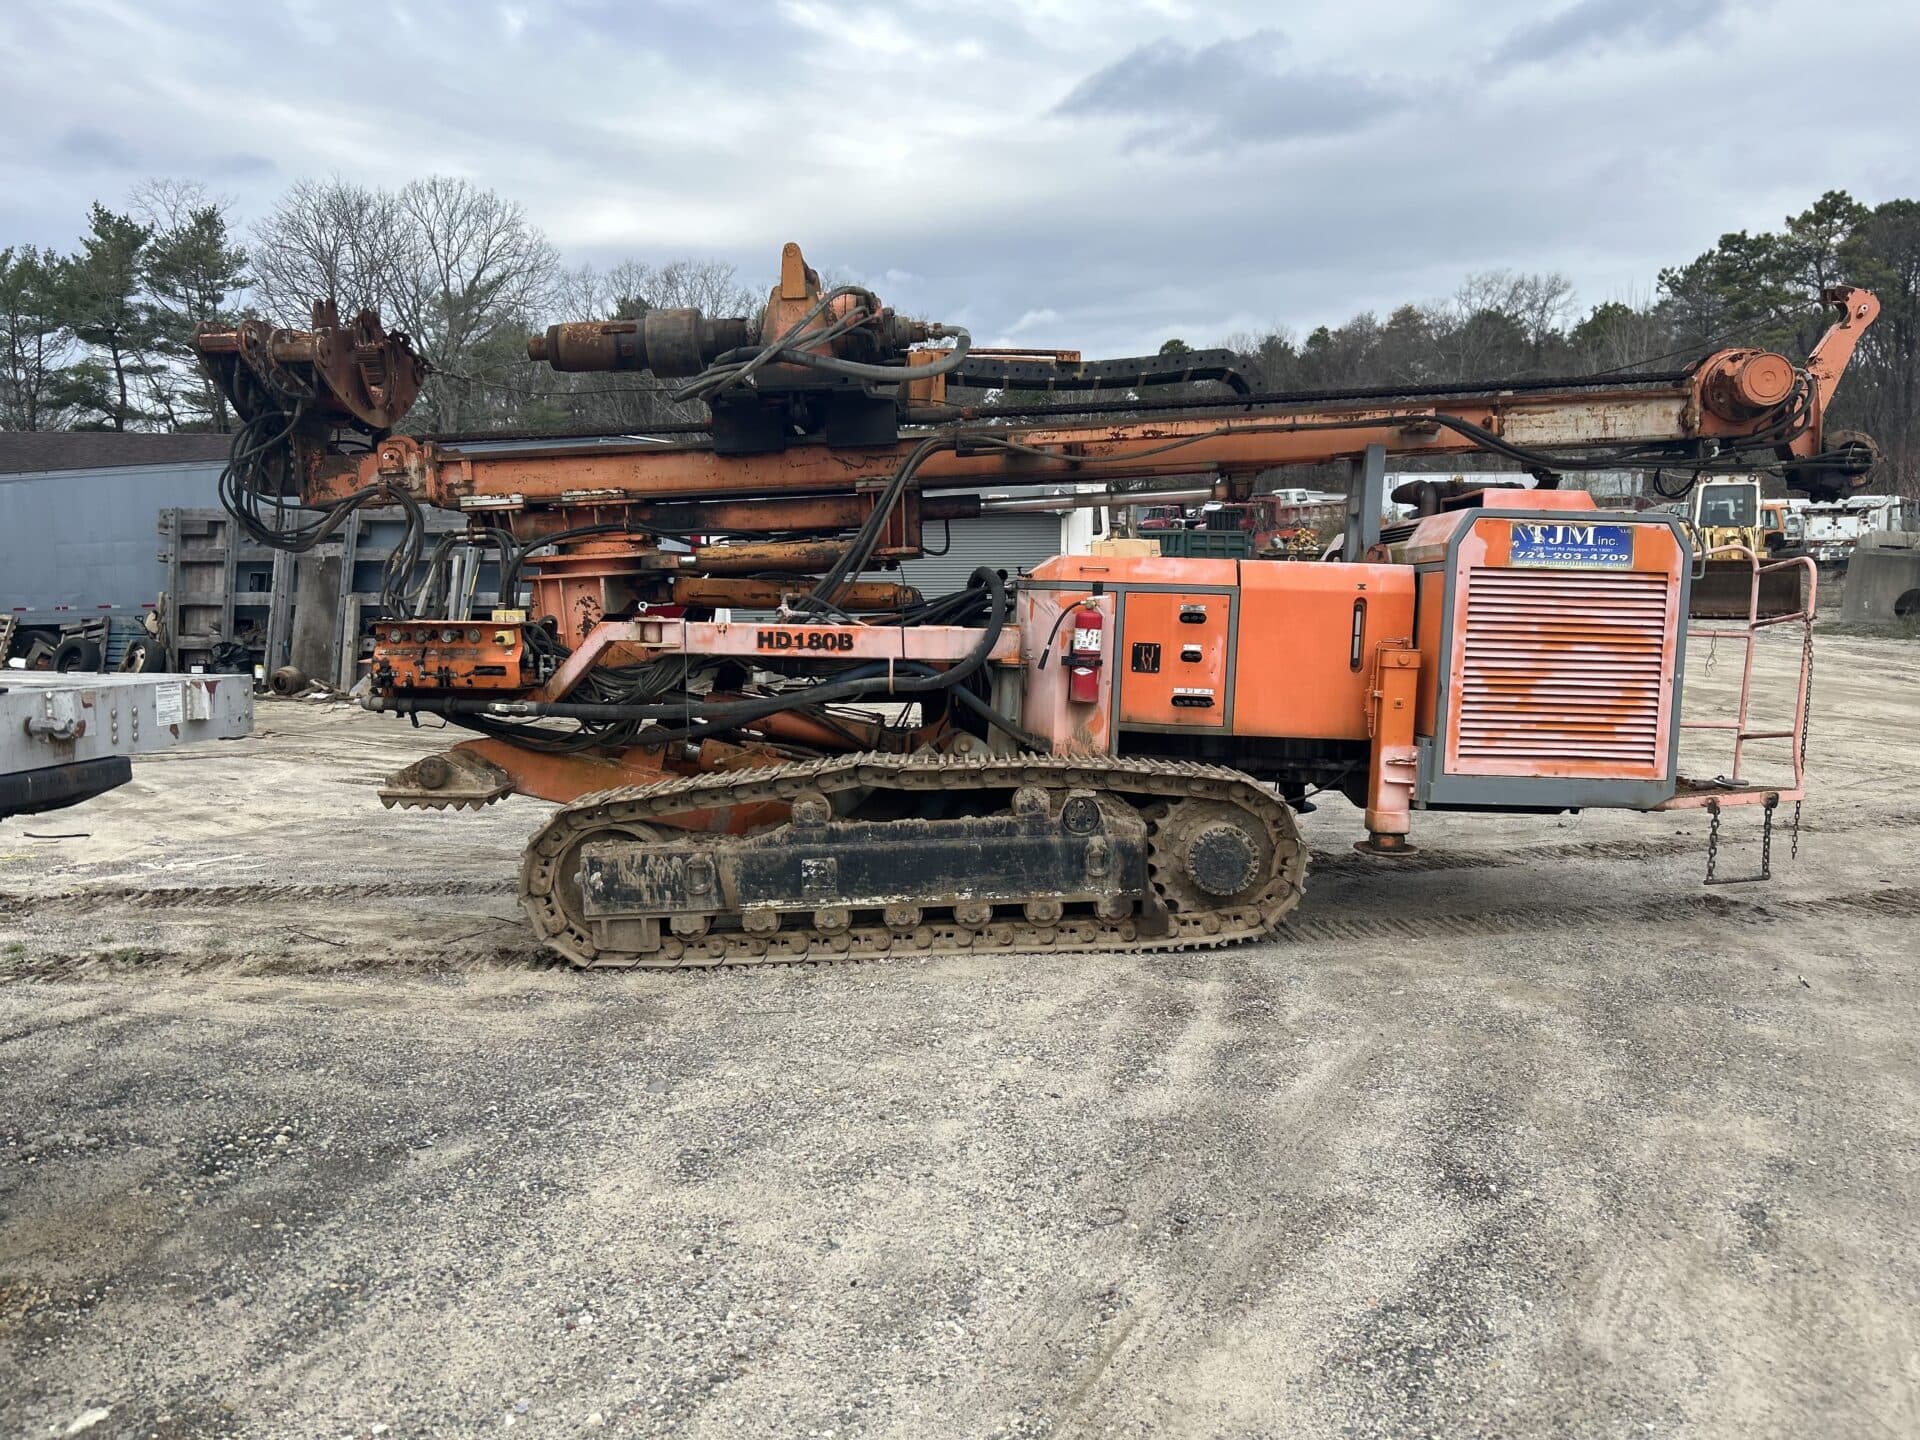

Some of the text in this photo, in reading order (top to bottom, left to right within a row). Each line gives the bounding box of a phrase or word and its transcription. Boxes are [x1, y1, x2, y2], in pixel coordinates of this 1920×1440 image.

[1528, 524, 1619, 547] TJM inc.
[1517, 552, 1629, 562] 724-203-4709
[757, 631, 854, 651] HD180B
